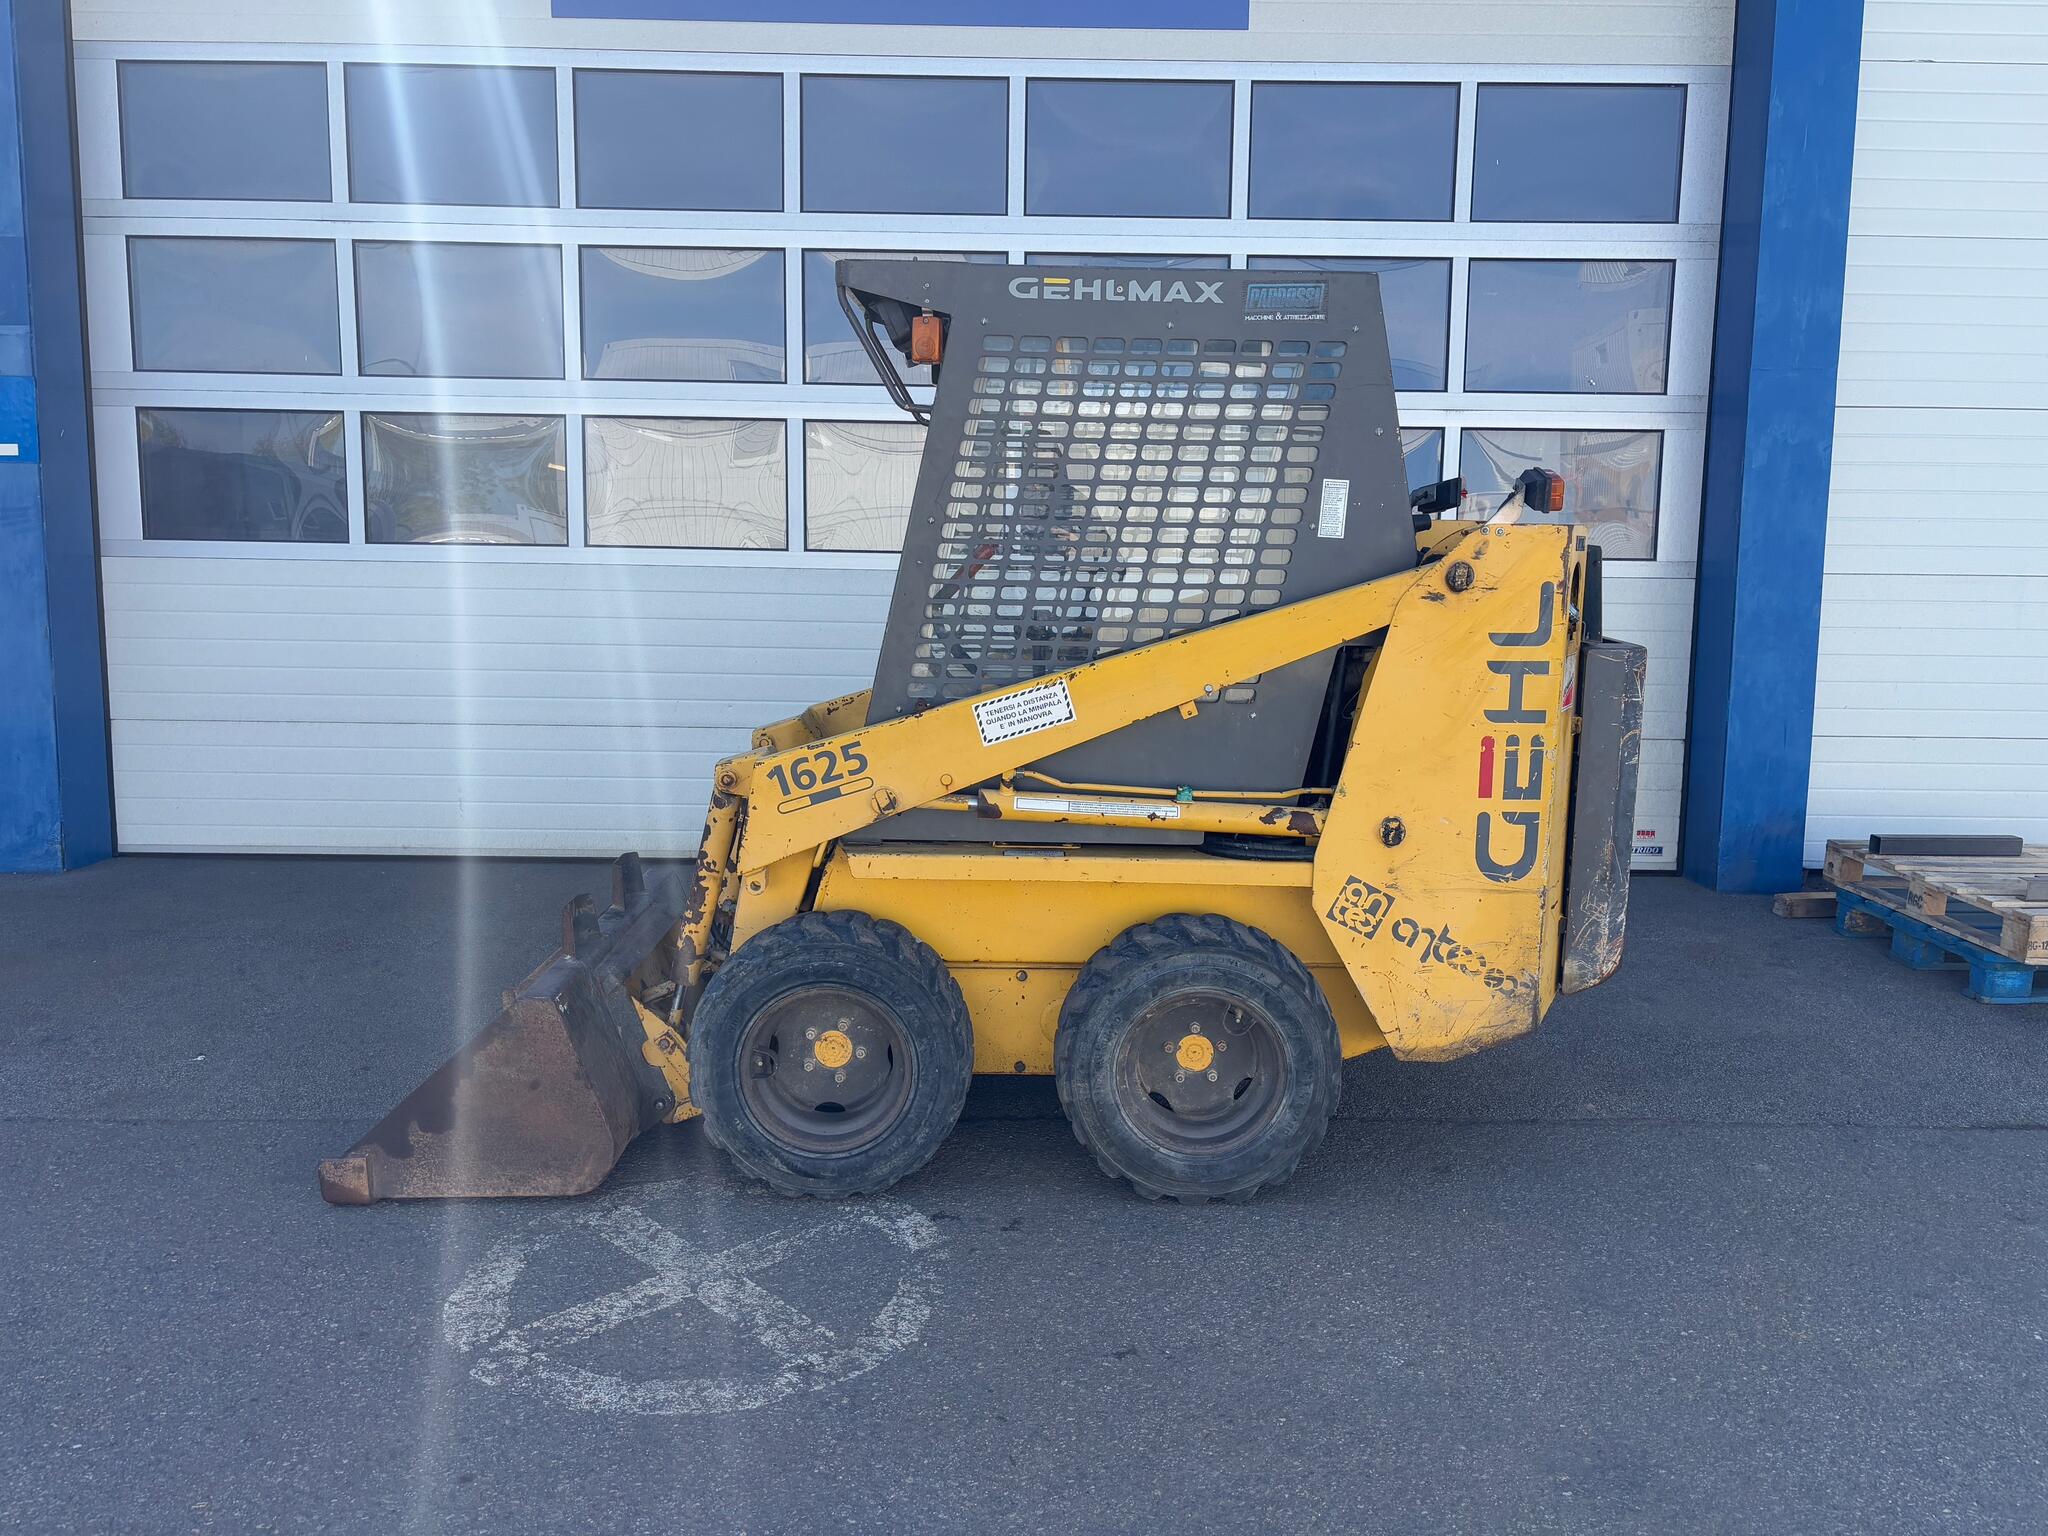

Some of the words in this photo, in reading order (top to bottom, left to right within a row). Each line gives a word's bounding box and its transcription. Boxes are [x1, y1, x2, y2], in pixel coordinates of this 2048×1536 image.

[1008, 277, 1224, 304] GEHLMAX
[1275, 311, 1282, 321] &
[985, 704, 1016, 717] TENERSI
[1023, 692, 1058, 706] DISTANZA
[986, 713, 1017, 725] QUANDO
[1028, 699, 1063, 713] MINIPALA
[1008, 720, 1016, 728] IN
[1017, 710, 1053, 724] MANOVRA
[1475, 581, 1555, 884] GEHL
[766, 741, 869, 797] 1625
